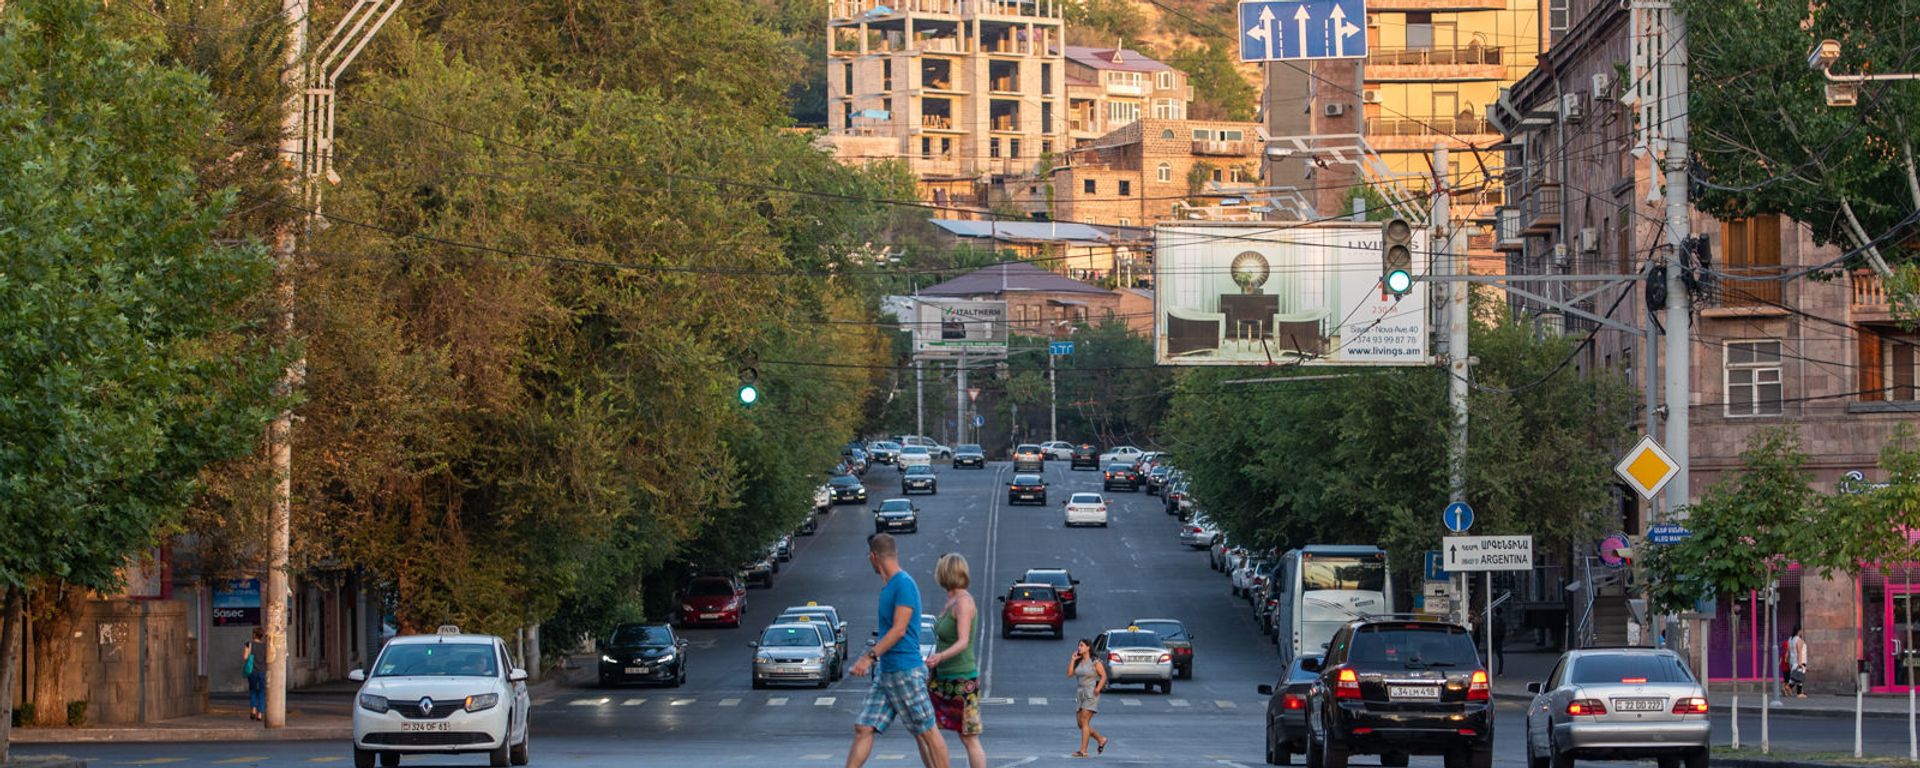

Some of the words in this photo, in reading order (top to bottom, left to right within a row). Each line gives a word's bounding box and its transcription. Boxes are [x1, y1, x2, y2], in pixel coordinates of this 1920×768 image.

[1347, 240, 1419, 250] LIVIS
[956, 308, 1001, 316] ITALTHERM
[1347, 346, 1421, 357] www.livings.am
[1480, 554, 1529, 565] ARGENTINA
[213, 608, 245, 618] 5asec
[411, 721, 425, 731] 324
